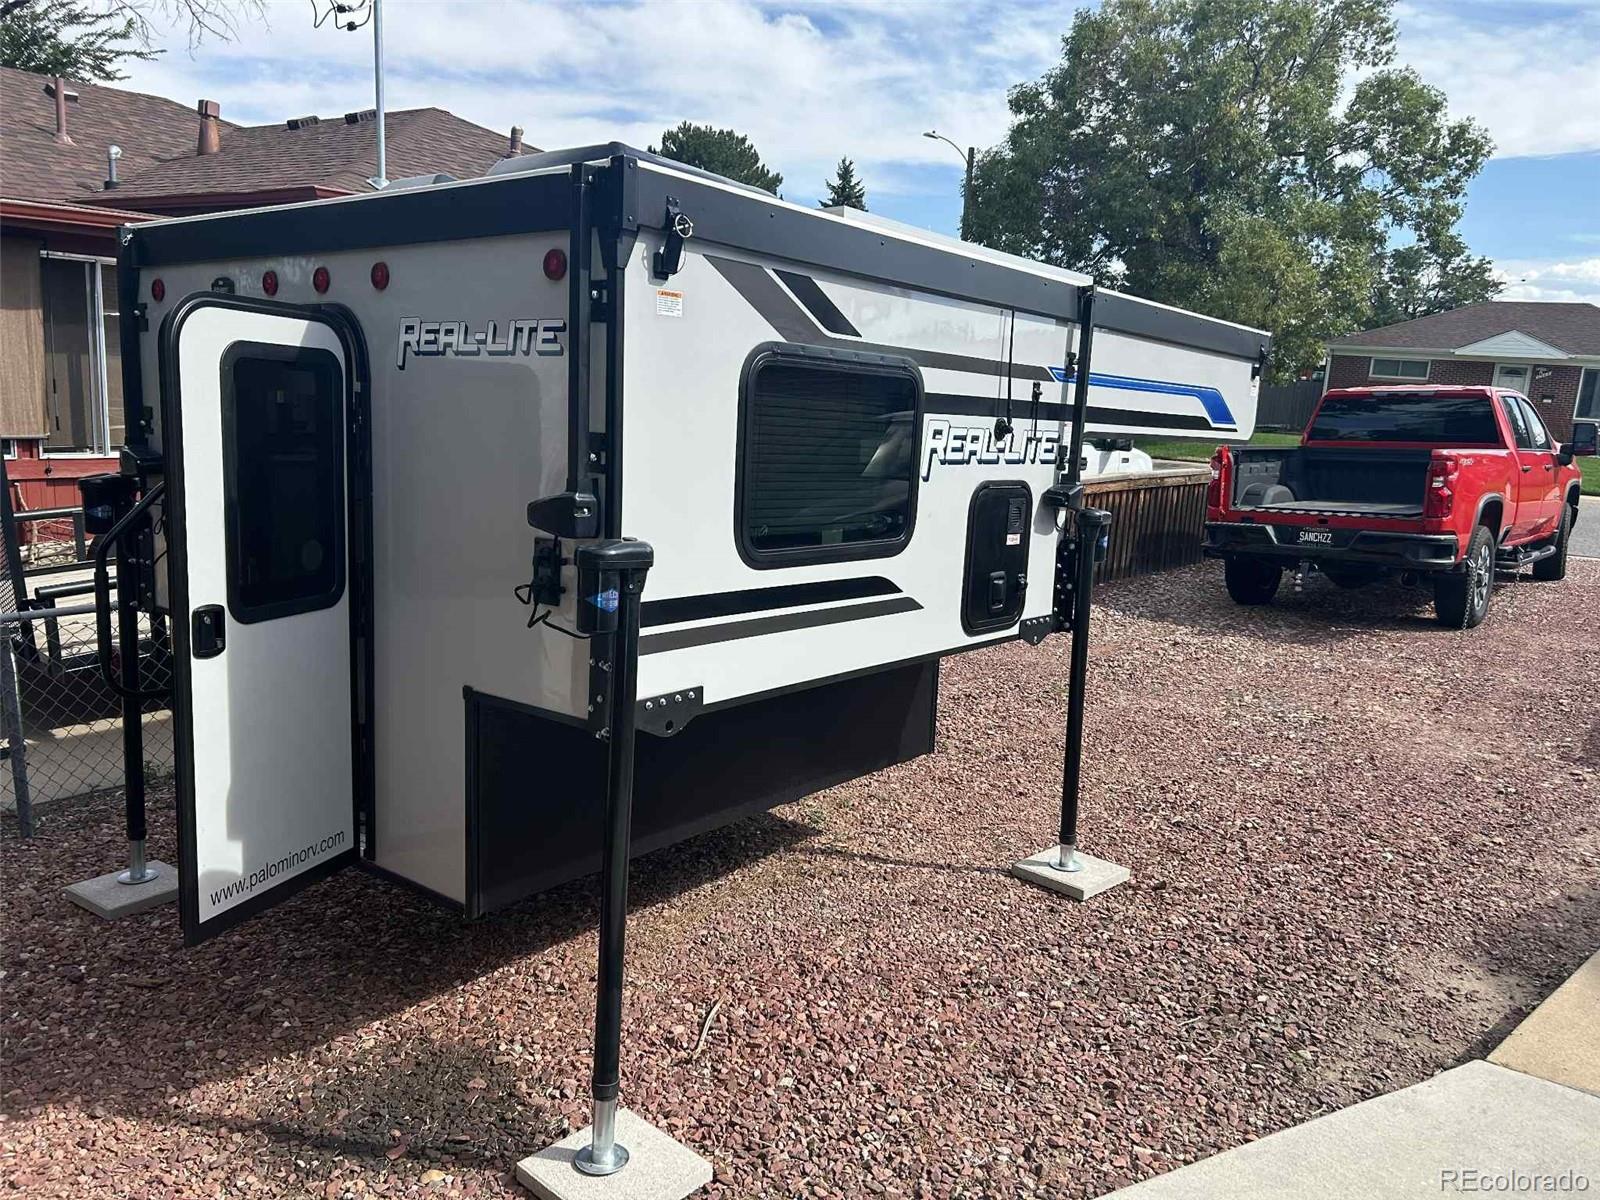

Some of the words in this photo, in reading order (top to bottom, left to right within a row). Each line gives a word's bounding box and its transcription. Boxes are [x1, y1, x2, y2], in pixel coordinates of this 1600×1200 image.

[397, 316, 567, 370] REAL-LITE
[1299, 531, 1332, 543] SANCHZZ
[210, 830, 345, 906] www.palominorv.com
